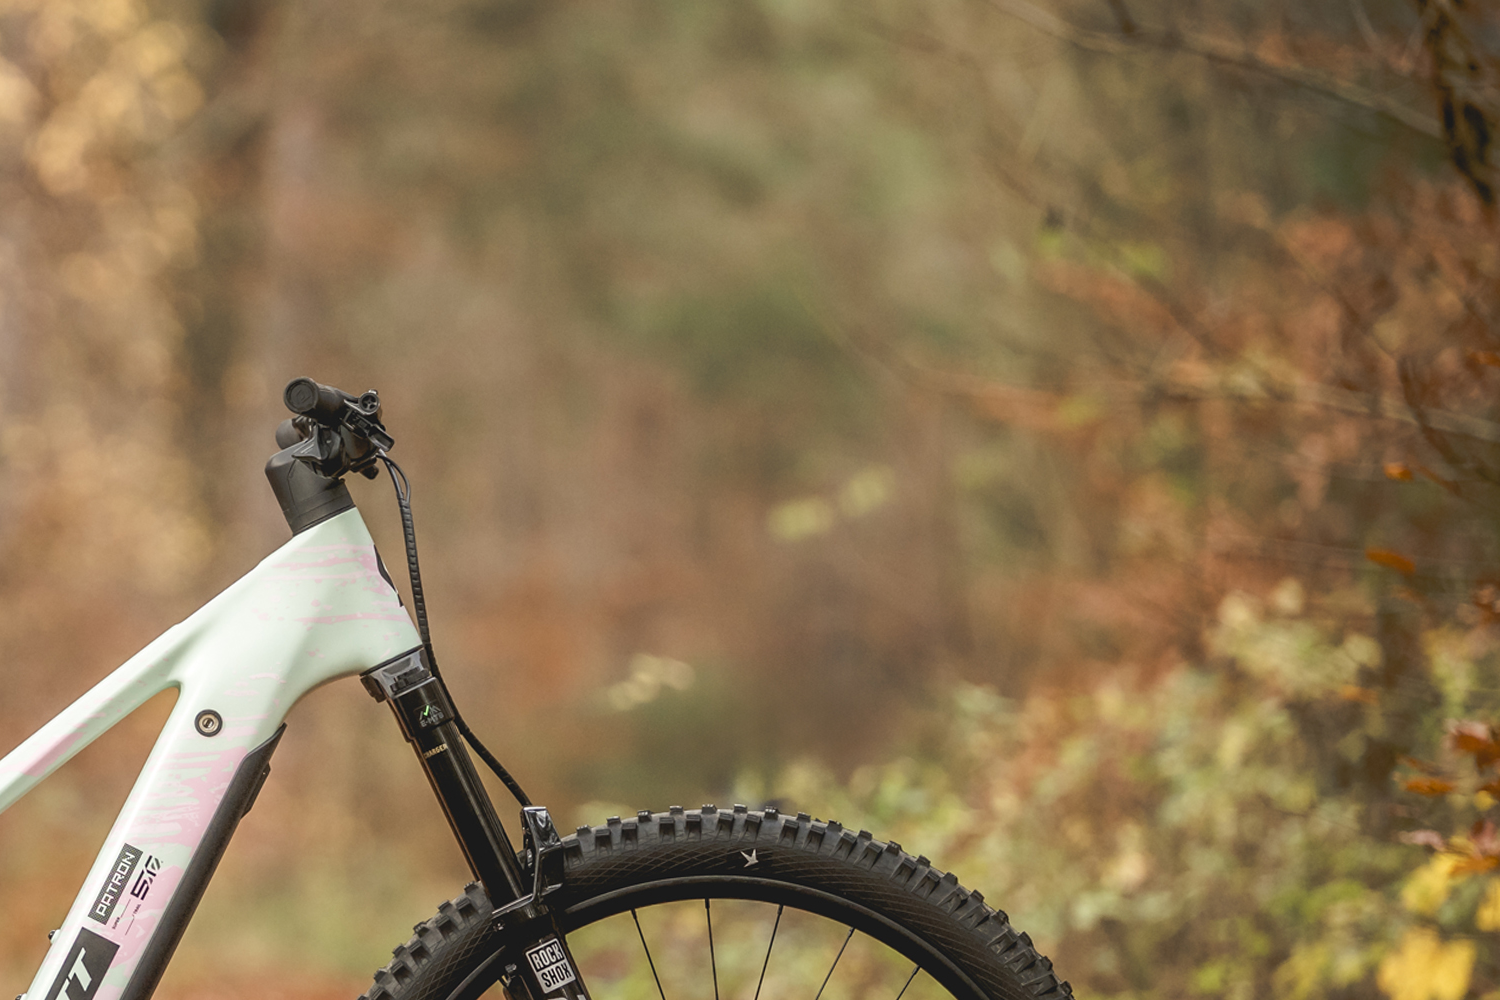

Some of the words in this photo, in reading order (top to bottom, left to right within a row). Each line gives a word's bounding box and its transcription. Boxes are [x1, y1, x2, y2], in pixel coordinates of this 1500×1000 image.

[95, 852, 135, 916] PATRON
[531, 943, 563, 970] ROCK
[541, 962, 571, 988] SHOX
